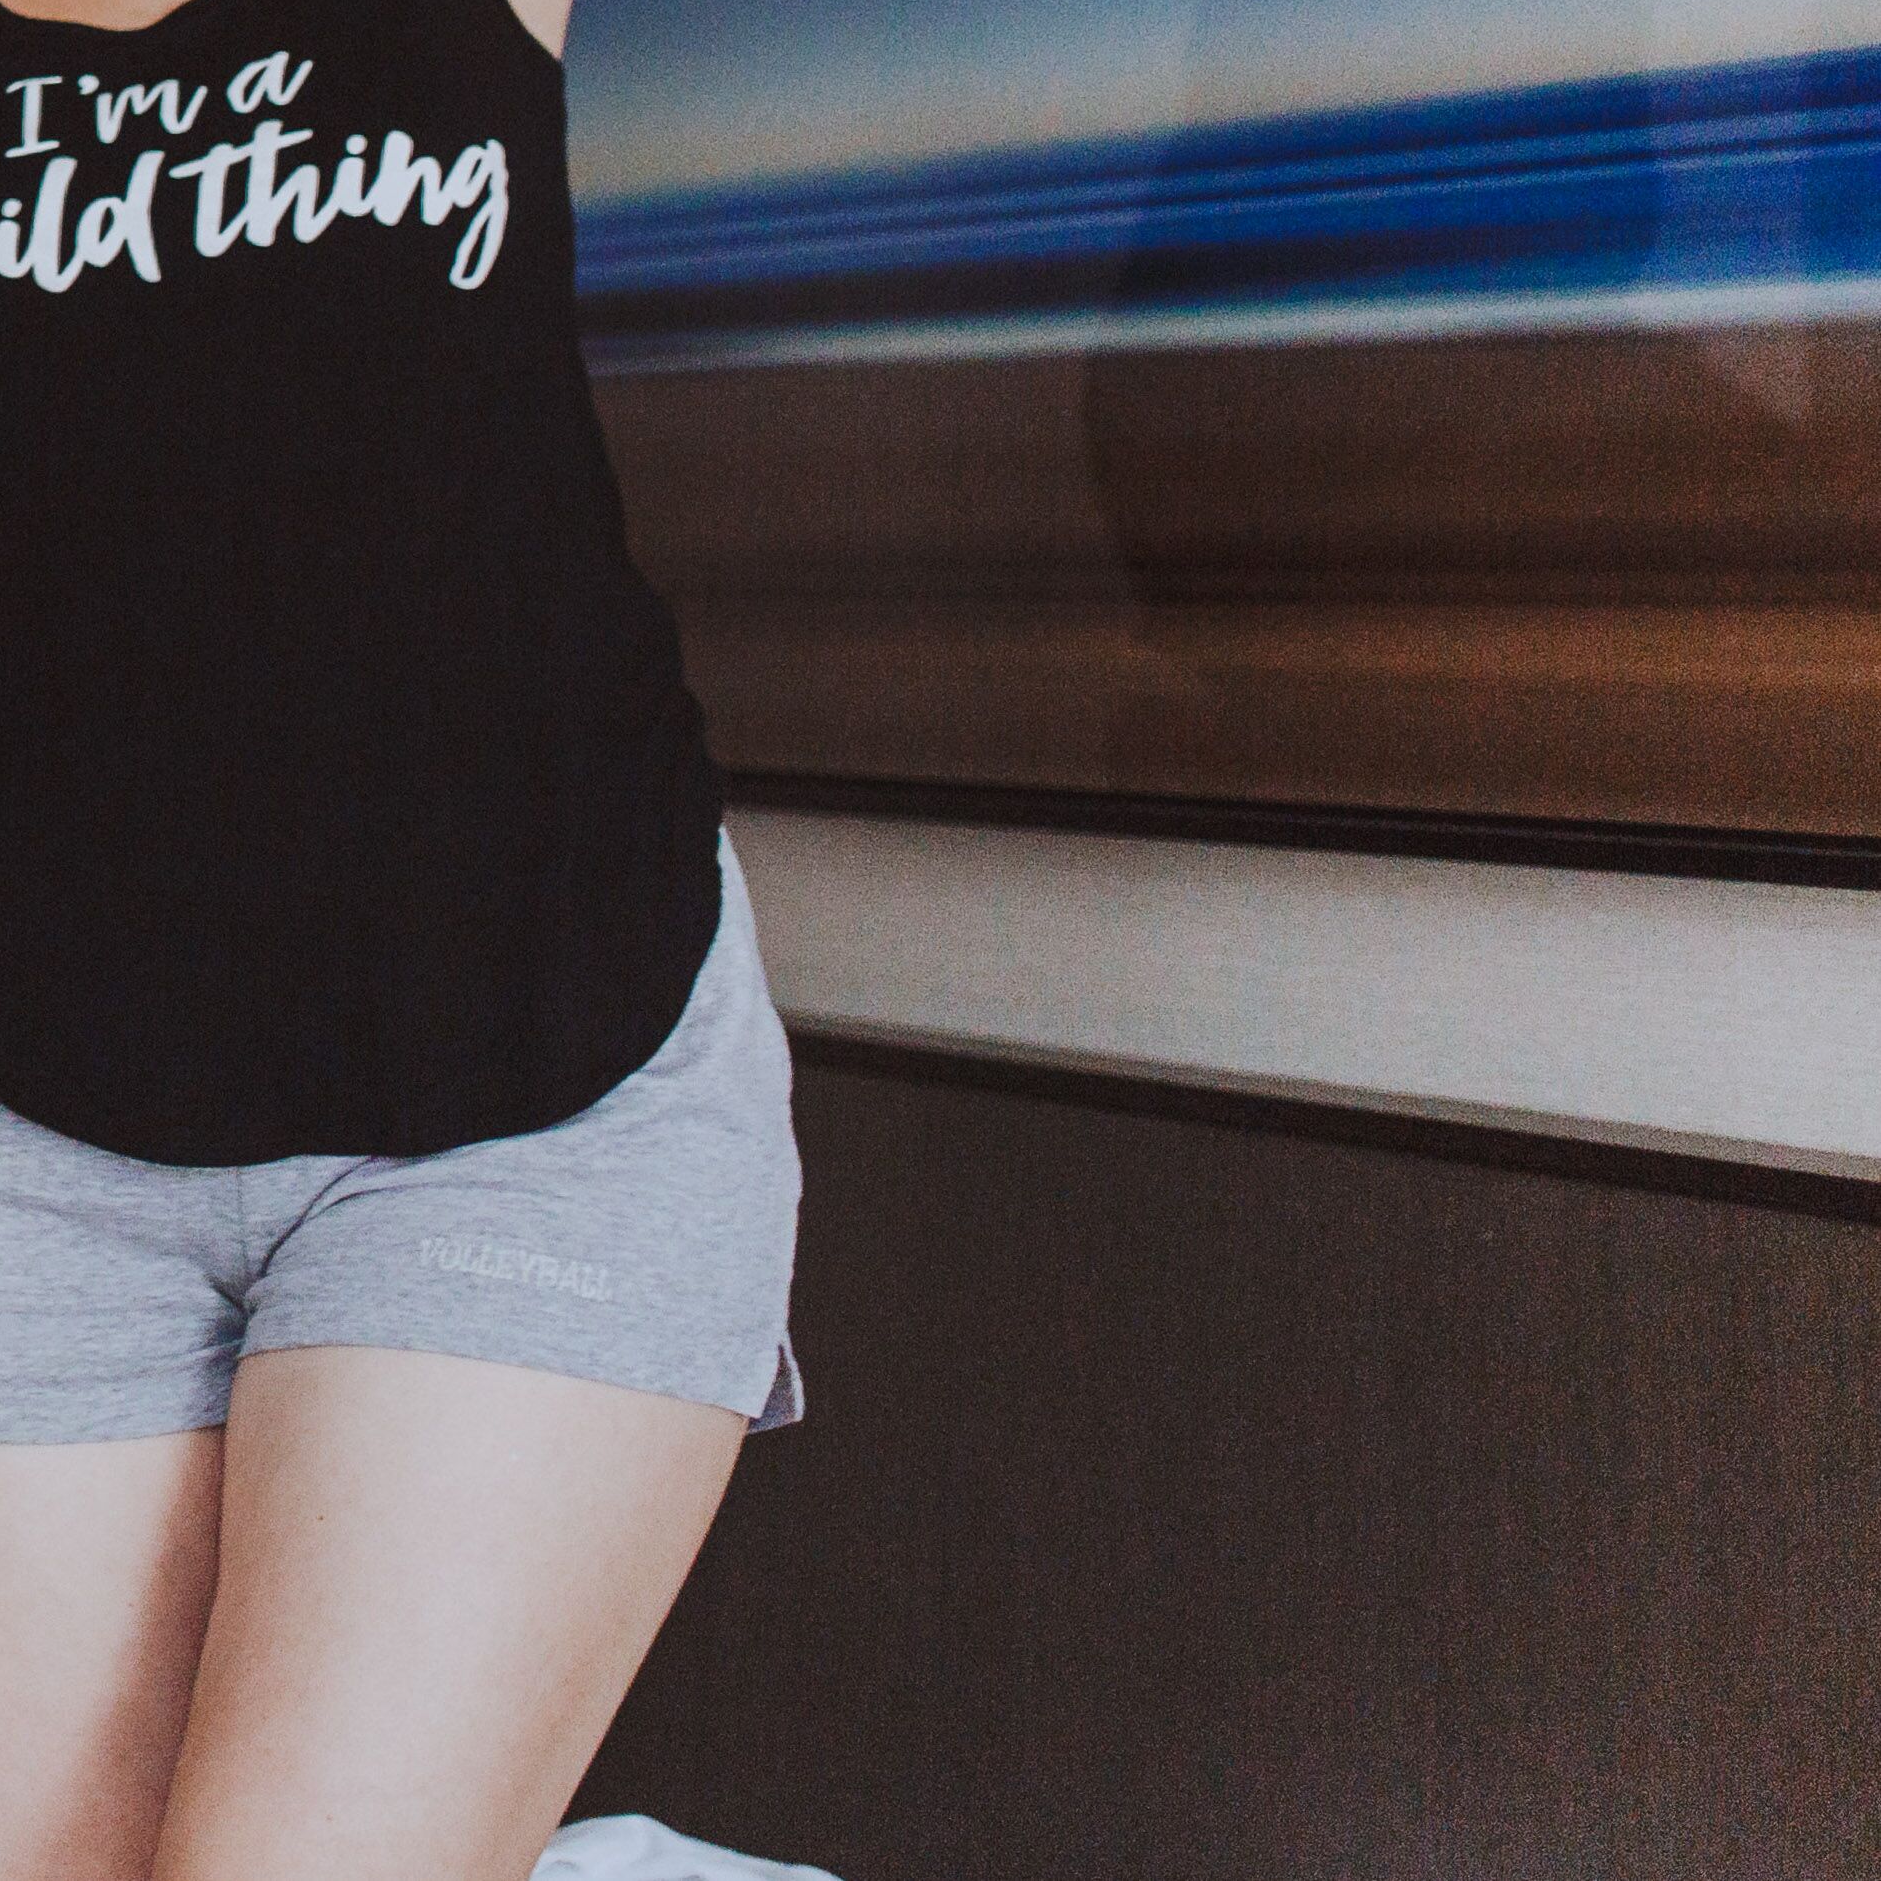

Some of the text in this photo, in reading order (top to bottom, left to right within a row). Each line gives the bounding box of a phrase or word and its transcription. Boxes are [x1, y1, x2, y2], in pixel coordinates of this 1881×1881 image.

[6, 50, 313, 159] I'm a
[168, 118, 510, 291] thing
[418, 1235, 614, 1302] VOLLEYBALL
